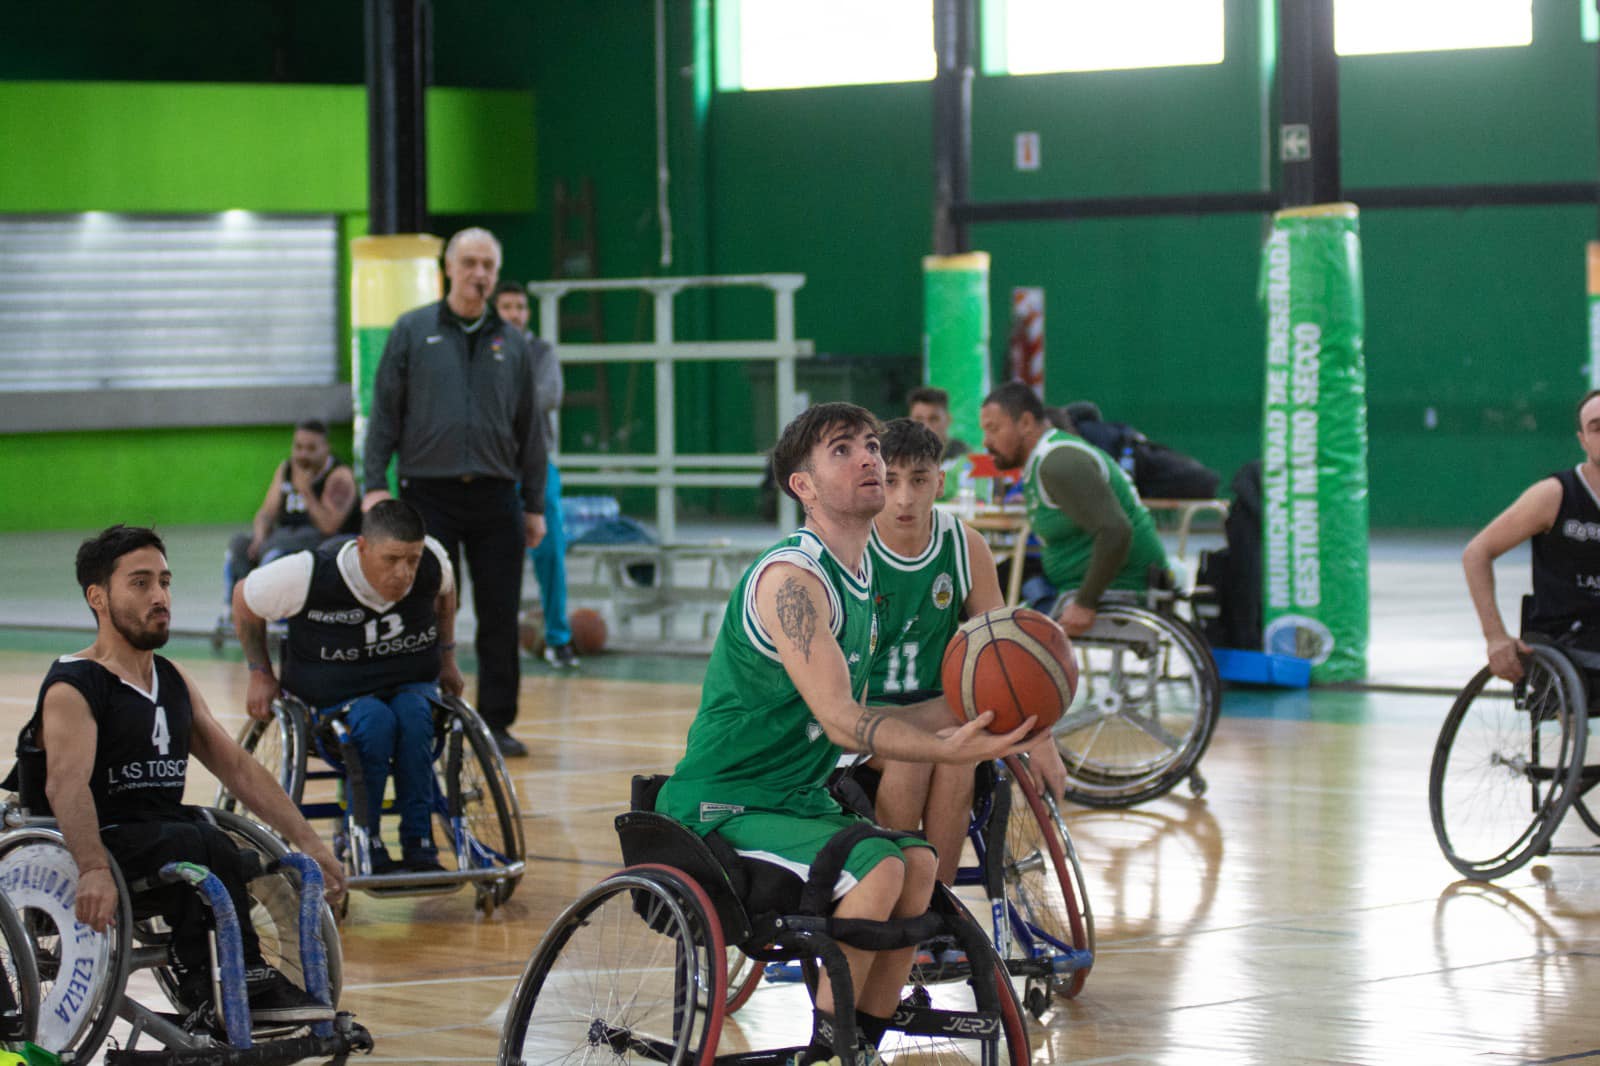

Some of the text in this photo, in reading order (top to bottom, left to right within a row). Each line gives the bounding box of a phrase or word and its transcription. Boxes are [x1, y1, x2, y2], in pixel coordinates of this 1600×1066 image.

[1267, 230, 1291, 607] MUNICIPALIDAD DE ENSENADA
[1291, 322, 1321, 607] GESTIÓN MARIO SECCO
[320, 646, 359, 661] LAS
[364, 626, 438, 658] TOSCAS
[365, 613, 405, 644] 13
[883, 642, 919, 693] 11
[152, 706, 171, 756] 4
[146, 759, 186, 777] TOSC
[54, 957, 95, 1024] EZEIZA
